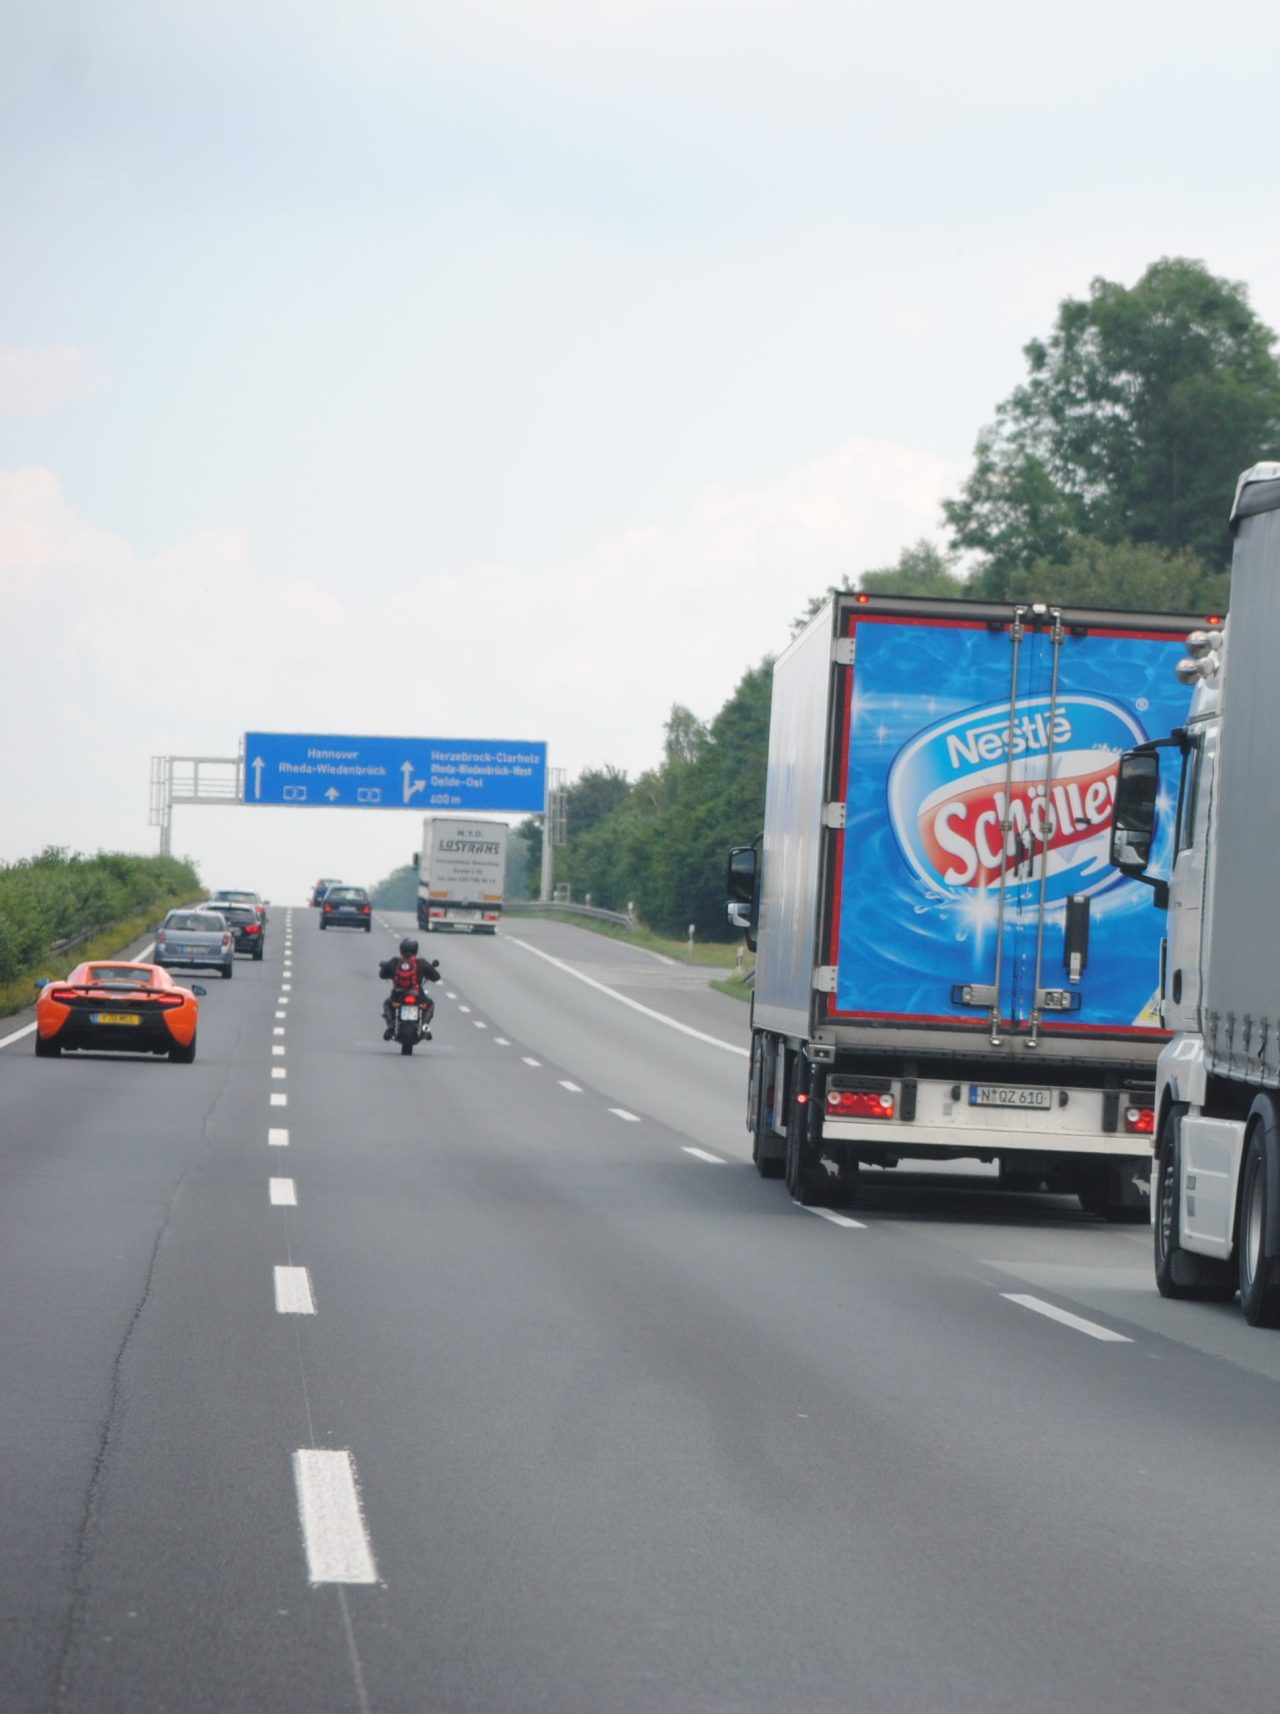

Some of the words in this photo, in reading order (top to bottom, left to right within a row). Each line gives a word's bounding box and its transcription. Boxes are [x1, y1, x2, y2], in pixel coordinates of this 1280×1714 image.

[946, 707, 1072, 769] Nestlé
[307, 748, 359, 760] Hannover
[431, 751, 540, 764] Herzebrock-Clarholz
[278, 762, 386, 776] Rheda-Wiedenbrück
[431, 763, 532, 776] Rheda-Wiedenbrück-West
[431, 776, 484, 788] Oelde-Ost
[1019, 1092, 1044, 1105] 610
